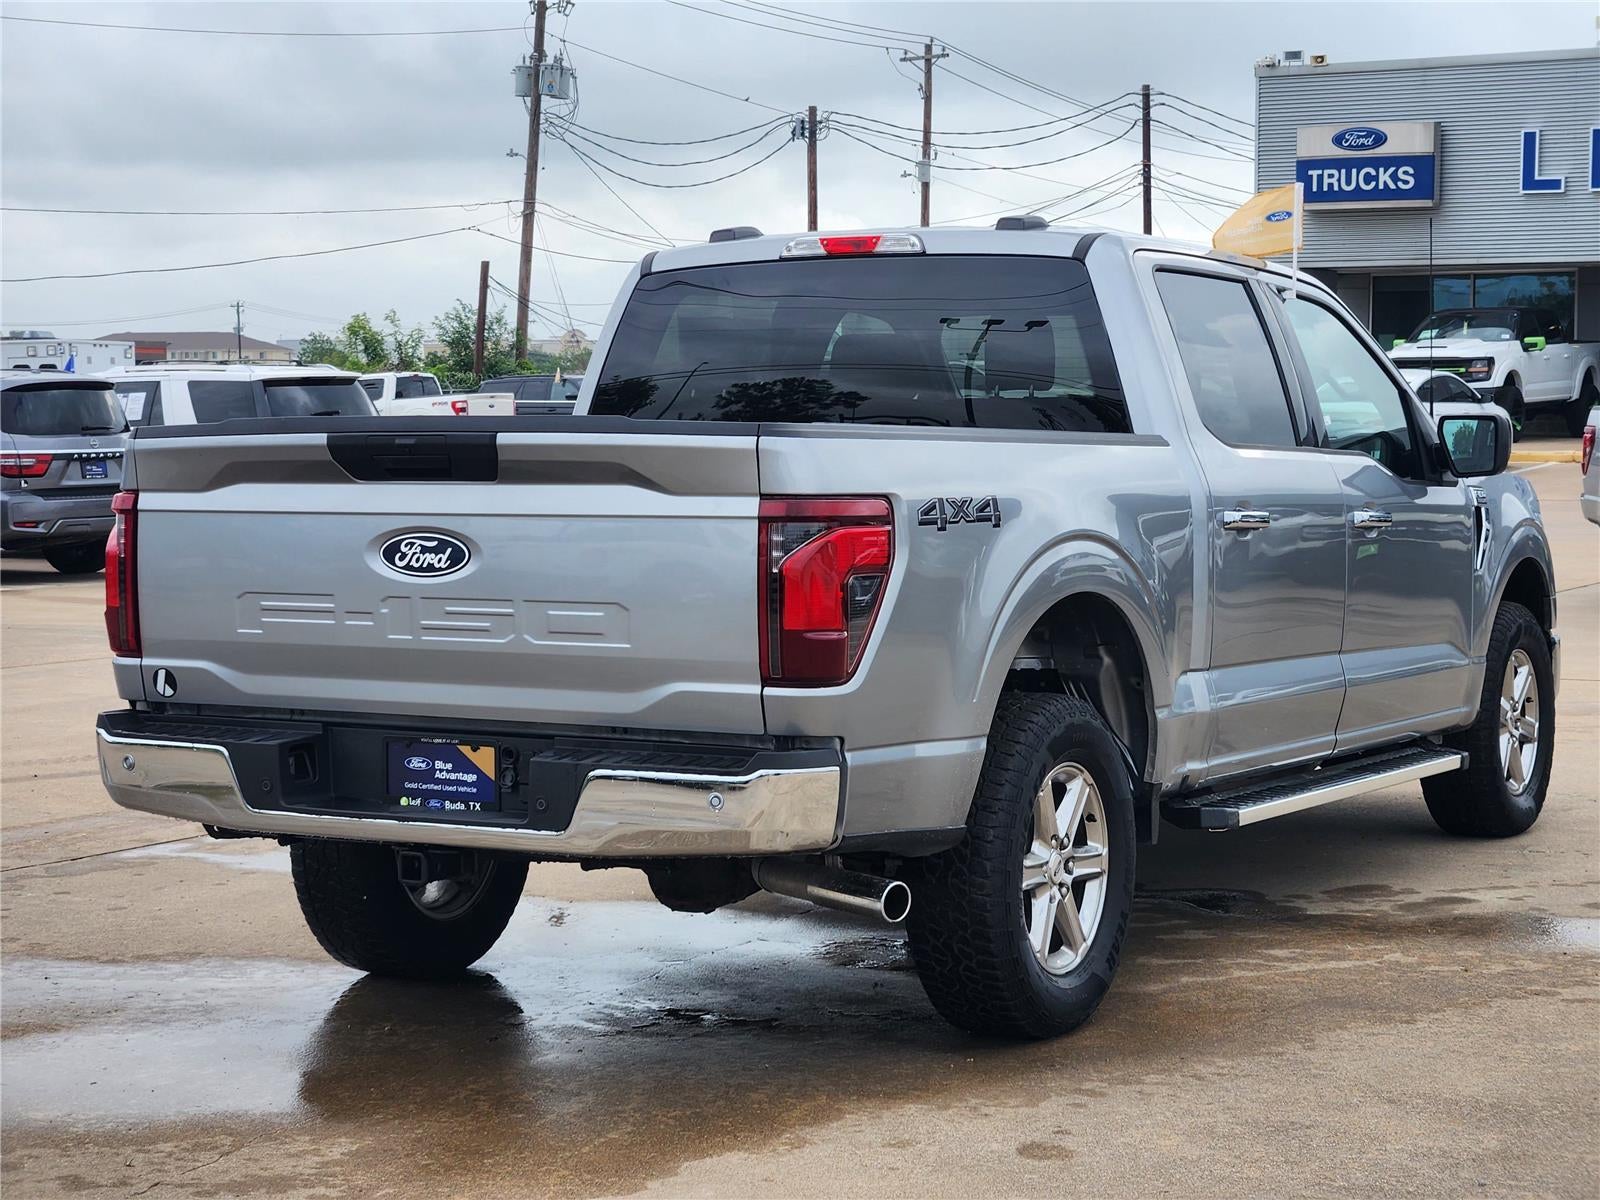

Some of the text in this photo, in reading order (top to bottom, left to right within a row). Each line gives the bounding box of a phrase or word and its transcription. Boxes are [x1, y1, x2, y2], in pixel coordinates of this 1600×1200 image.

[1342, 131, 1375, 147] Ford
[1520, 127, 1600, 194] L
[1307, 166, 1415, 192] TRUCKS
[394, 538, 453, 569] Ford
[236, 591, 631, 648] F-150
[409, 758, 427, 768] Ford
[435, 761, 453, 770] Blue
[434, 770, 478, 782] Advantage
[418, 783, 441, 791] Certified
[469, 802, 481, 811] TX
